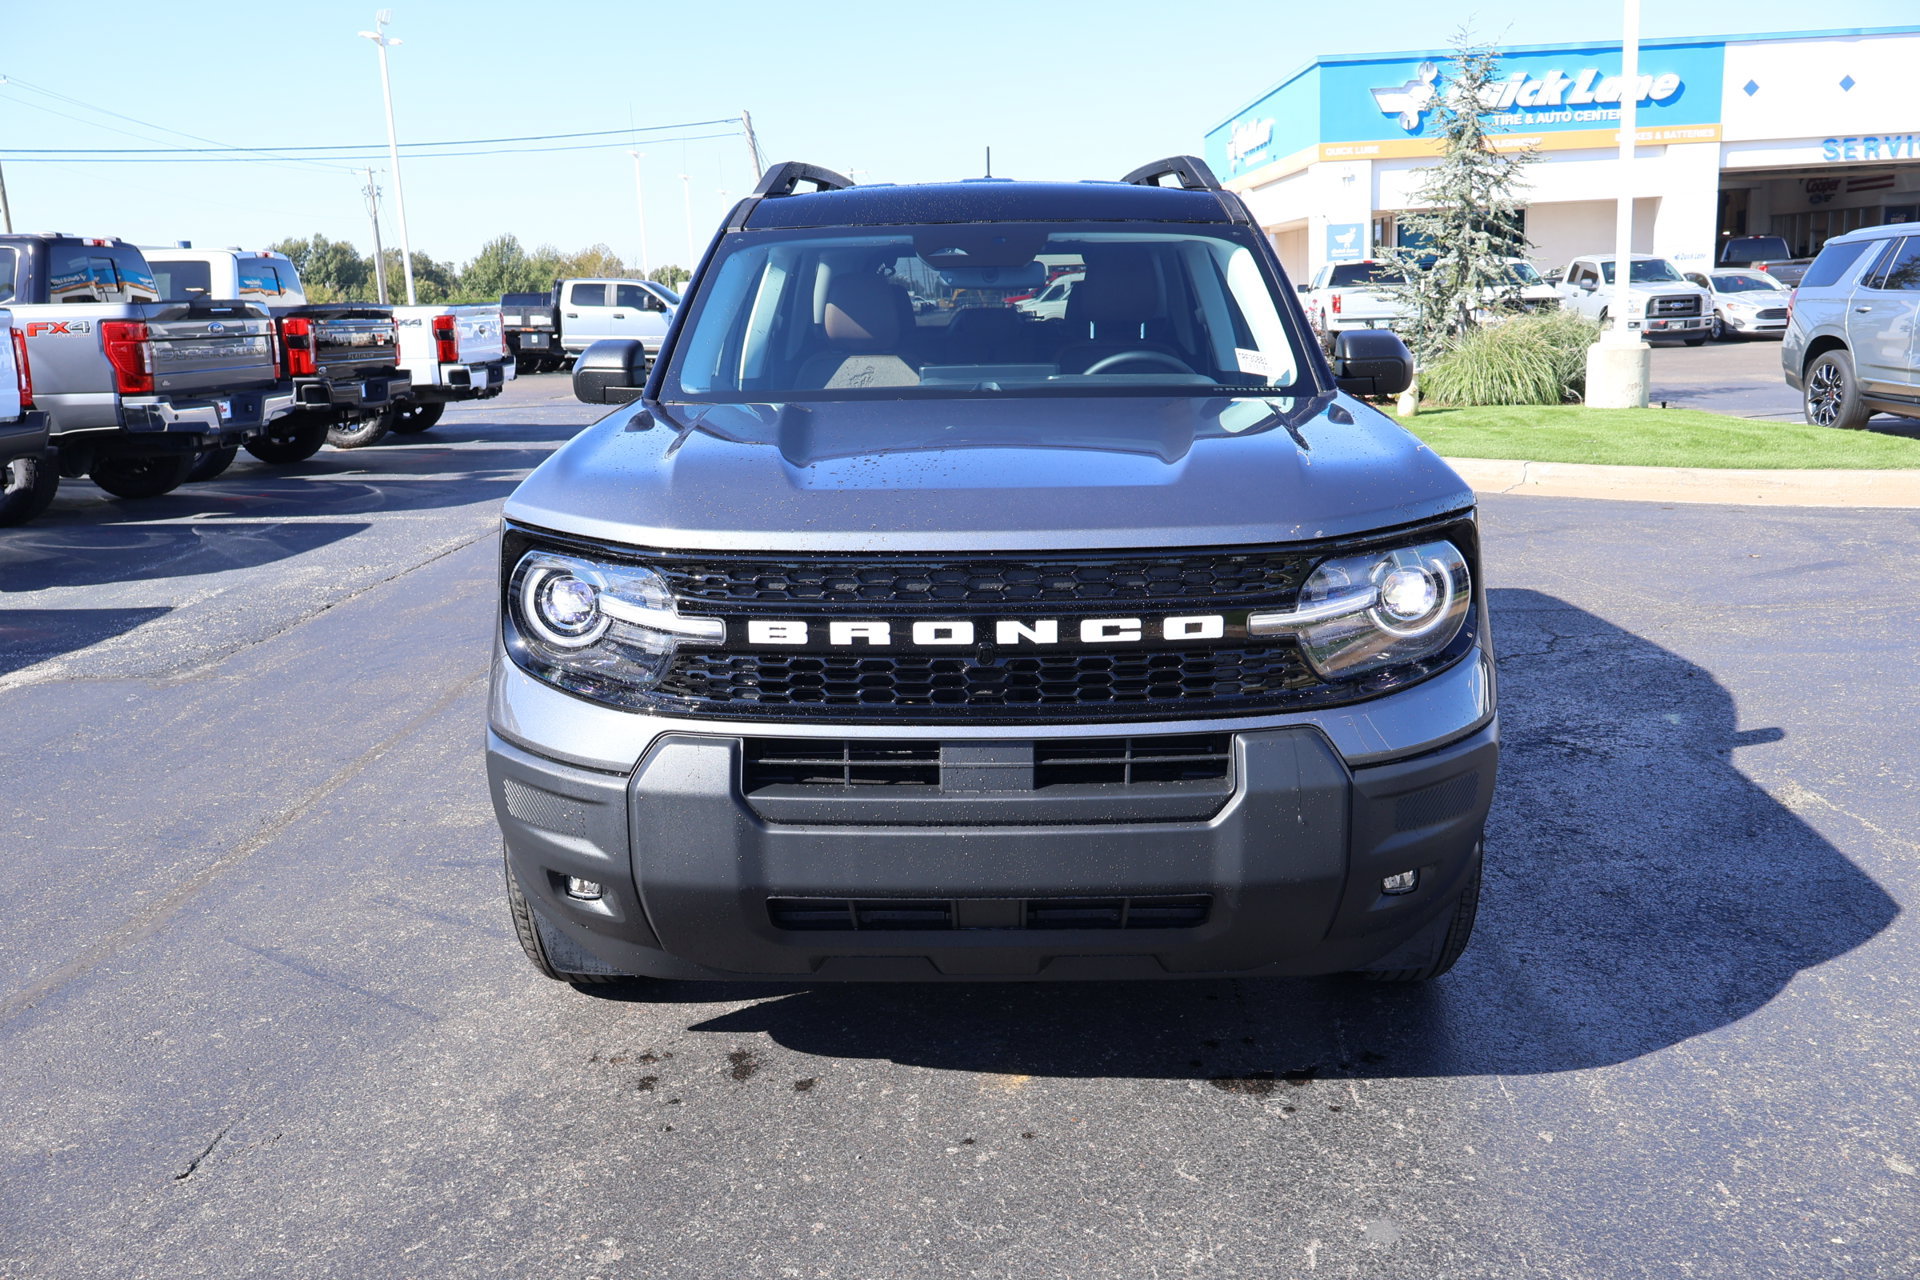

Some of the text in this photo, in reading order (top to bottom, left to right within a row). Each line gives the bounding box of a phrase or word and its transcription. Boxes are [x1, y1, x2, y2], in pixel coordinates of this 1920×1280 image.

[1492, 114, 1522, 126] TIRE
[1525, 113, 1534, 124] &
[1536, 111, 1571, 123] AUTO
[1615, 132, 1653, 142] BKES
[1663, 128, 1715, 139] BATTERIES
[1822, 134, 1920, 161] SERVI
[26, 320, 91, 338] FX4
[398, 318, 422, 326] X4
[748, 615, 1225, 645] BRONCO
